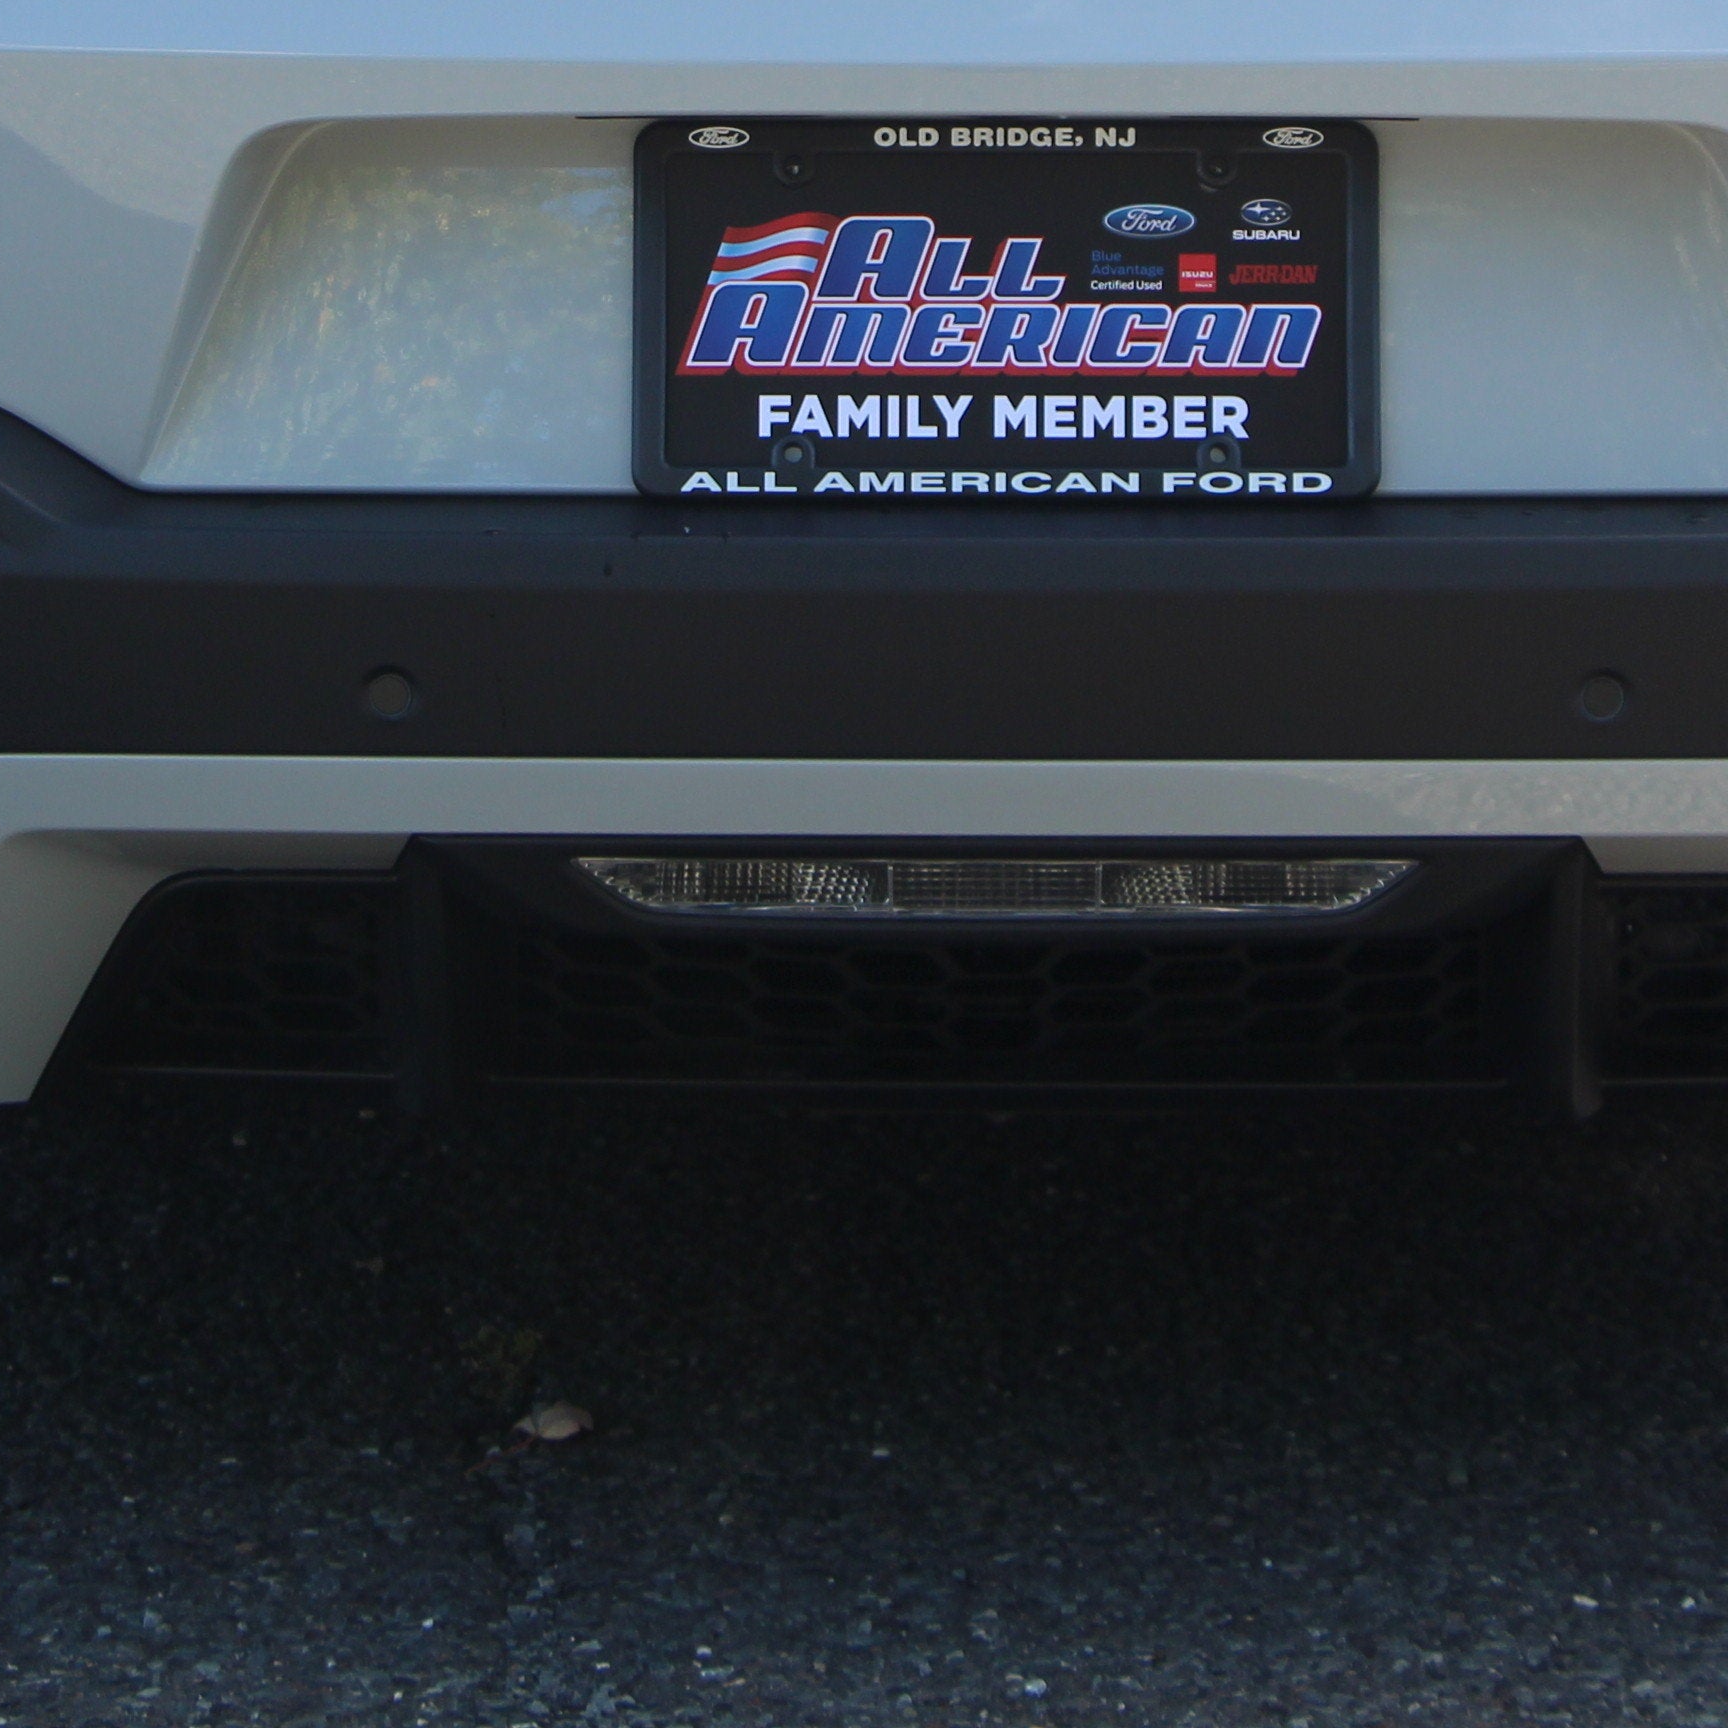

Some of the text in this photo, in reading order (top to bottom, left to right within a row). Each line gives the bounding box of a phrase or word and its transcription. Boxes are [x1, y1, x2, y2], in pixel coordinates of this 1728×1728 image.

[874, 127, 1136, 147] OLD BRIDGE, NJ
[1121, 208, 1177, 232] Ford
[1232, 229, 1301, 241] SUBARU
[1092, 250, 1122, 261] Blue
[1092, 264, 1165, 278] Advantage
[1091, 280, 1163, 290] Certified Used
[758, 394, 1249, 439] FAMILY MEMBER
[680, 471, 1333, 493] ALL AMERICAN FORD
